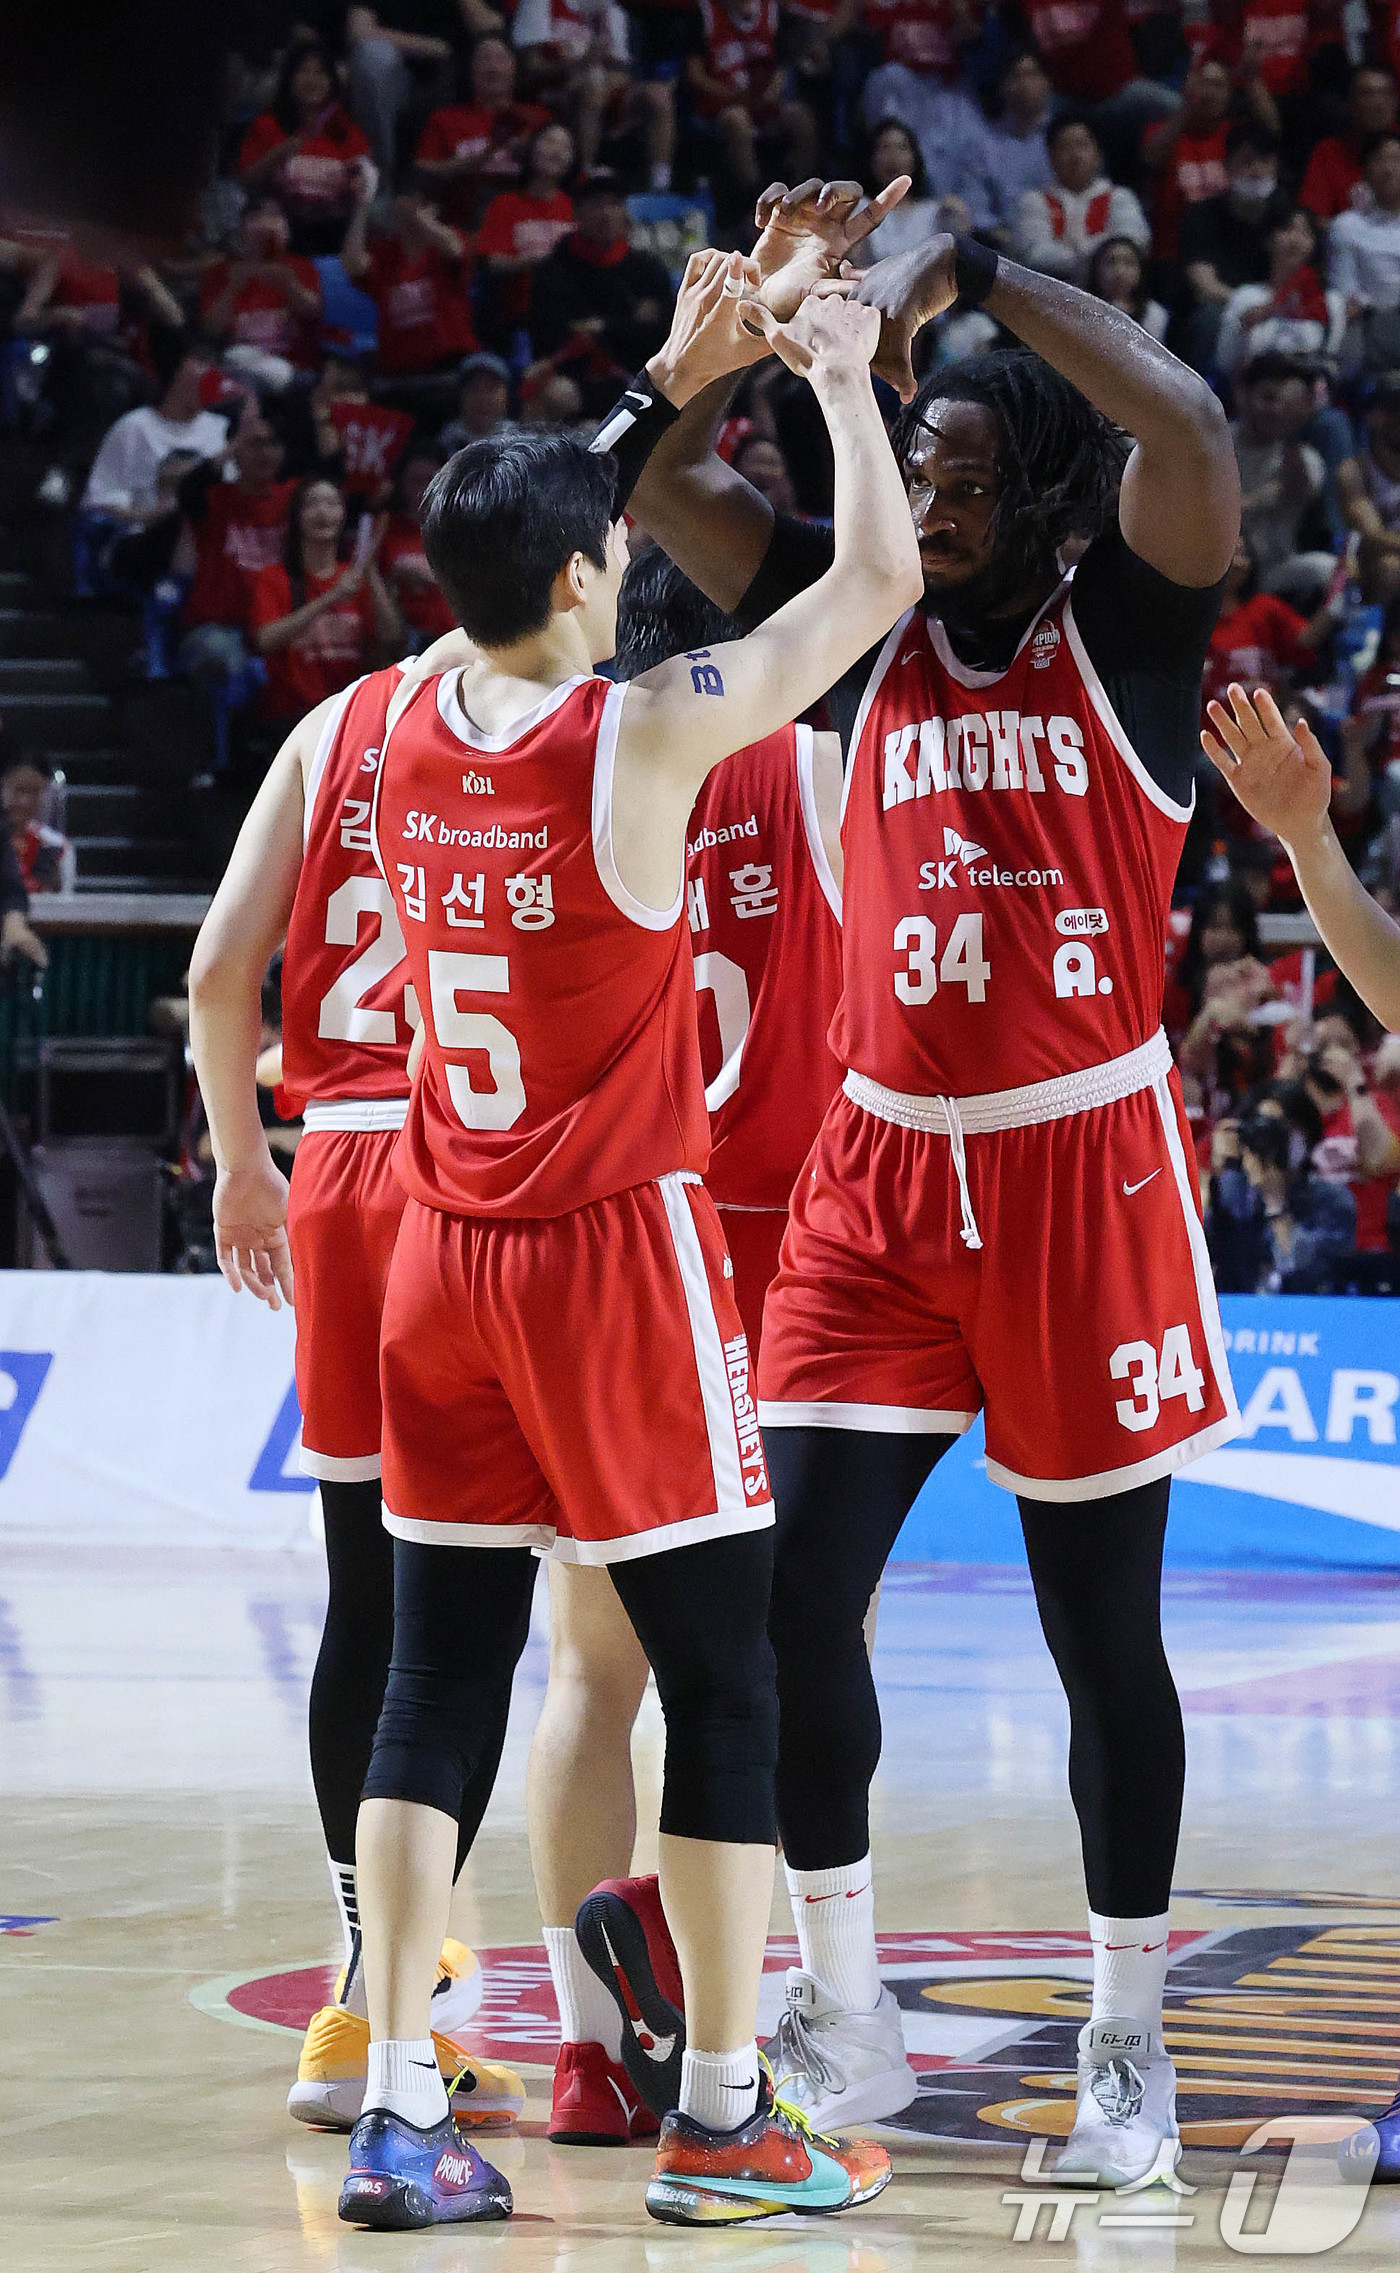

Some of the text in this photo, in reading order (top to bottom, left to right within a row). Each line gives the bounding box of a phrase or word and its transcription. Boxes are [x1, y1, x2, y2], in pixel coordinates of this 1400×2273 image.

[462, 770, 495, 795] KBL
[882, 710, 1090, 811] KNIGHTS
[402, 810, 548, 849] SK broadband
[918, 860, 1064, 891] SK telecom
[893, 912, 991, 1006] 34
[1063, 913, 1104, 930] 에이닷
[428, 950, 527, 1132] 5
[724, 1338, 769, 1497] HERSHEY'S
[1109, 1323, 1206, 1433] 34
